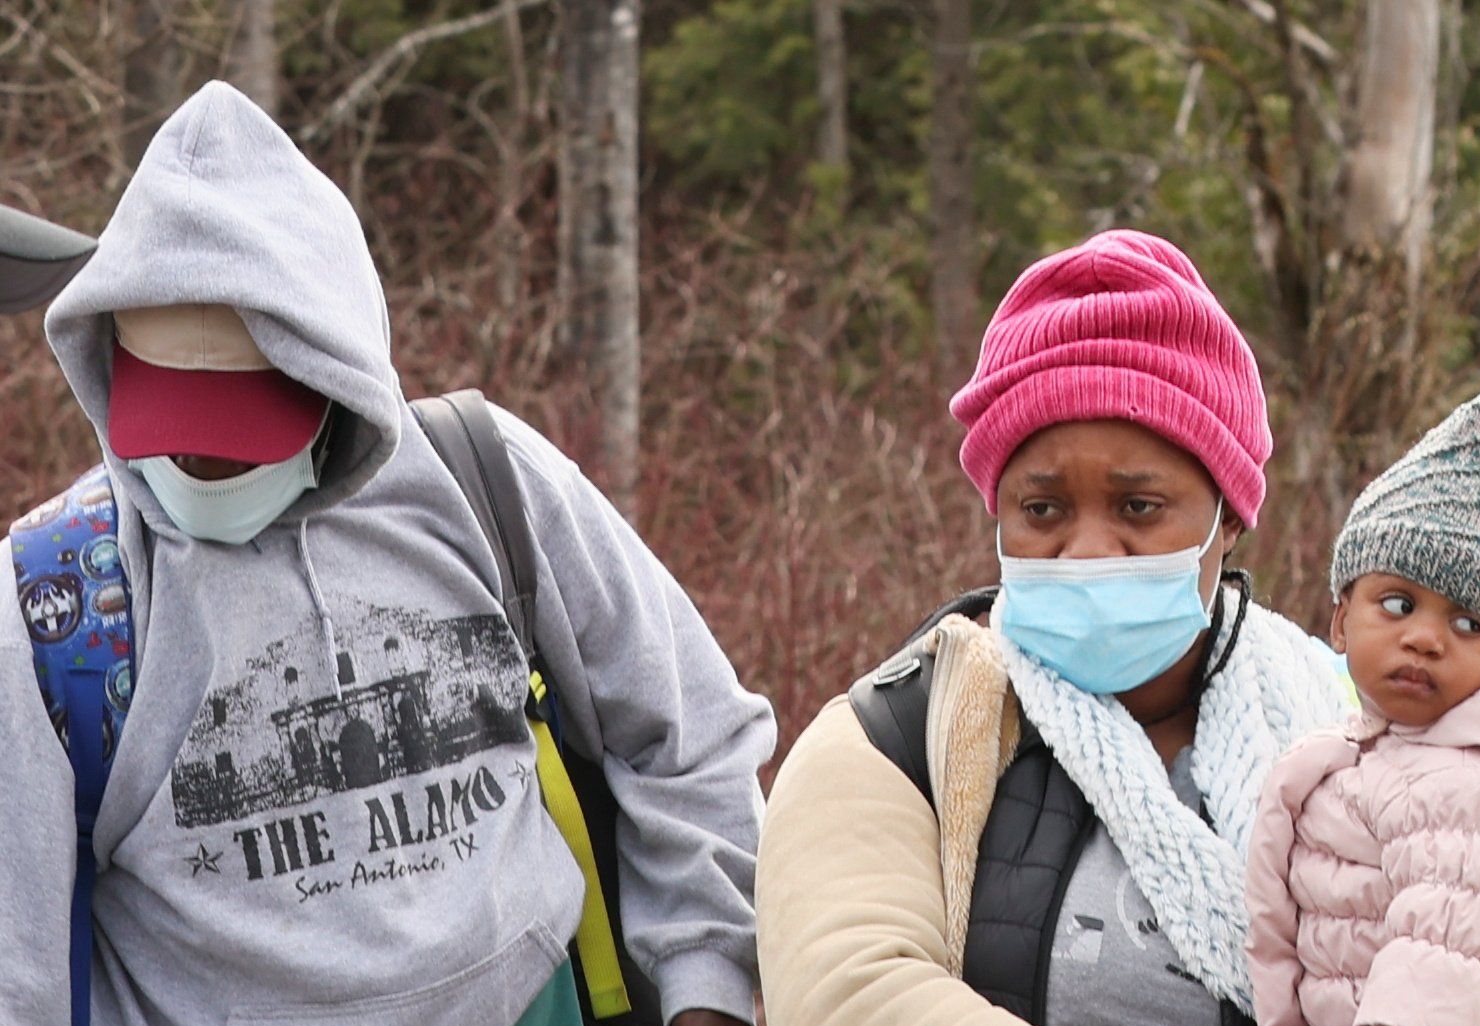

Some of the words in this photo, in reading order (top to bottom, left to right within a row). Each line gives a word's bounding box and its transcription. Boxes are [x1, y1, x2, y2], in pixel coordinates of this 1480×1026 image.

[233, 810, 335, 881] THE
[364, 766, 506, 853] ALAMO
[295, 875, 342, 903] San
[351, 853, 445, 889] Antonio,
[450, 833, 480, 861] TX
